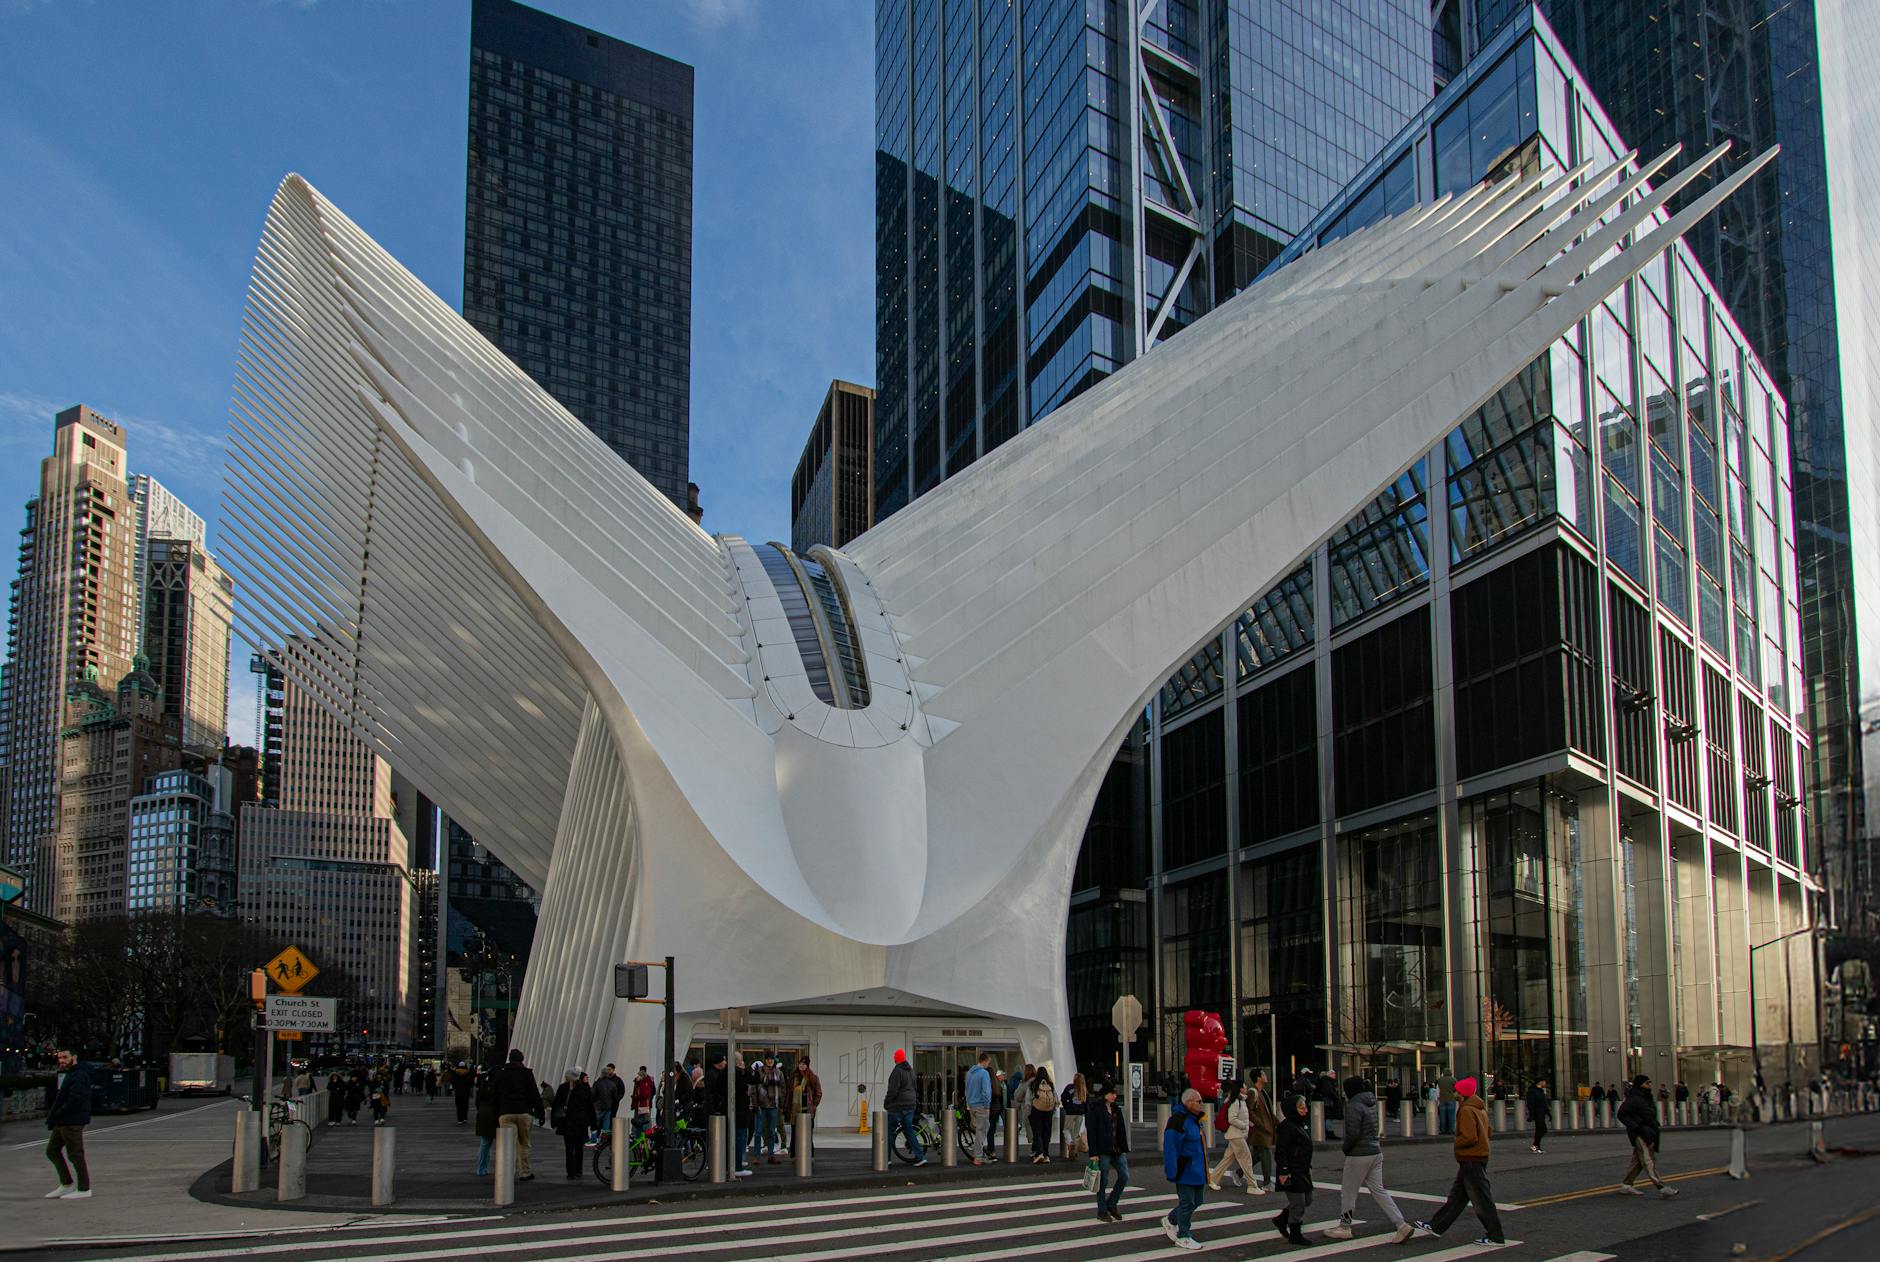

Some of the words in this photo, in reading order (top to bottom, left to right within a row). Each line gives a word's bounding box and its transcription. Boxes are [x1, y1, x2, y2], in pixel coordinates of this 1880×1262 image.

[275, 999, 307, 1007] Church
[311, 1000, 320, 1008] St
[271, 1009, 288, 1017] EXIT
[291, 1010, 323, 1018] CLOSED
